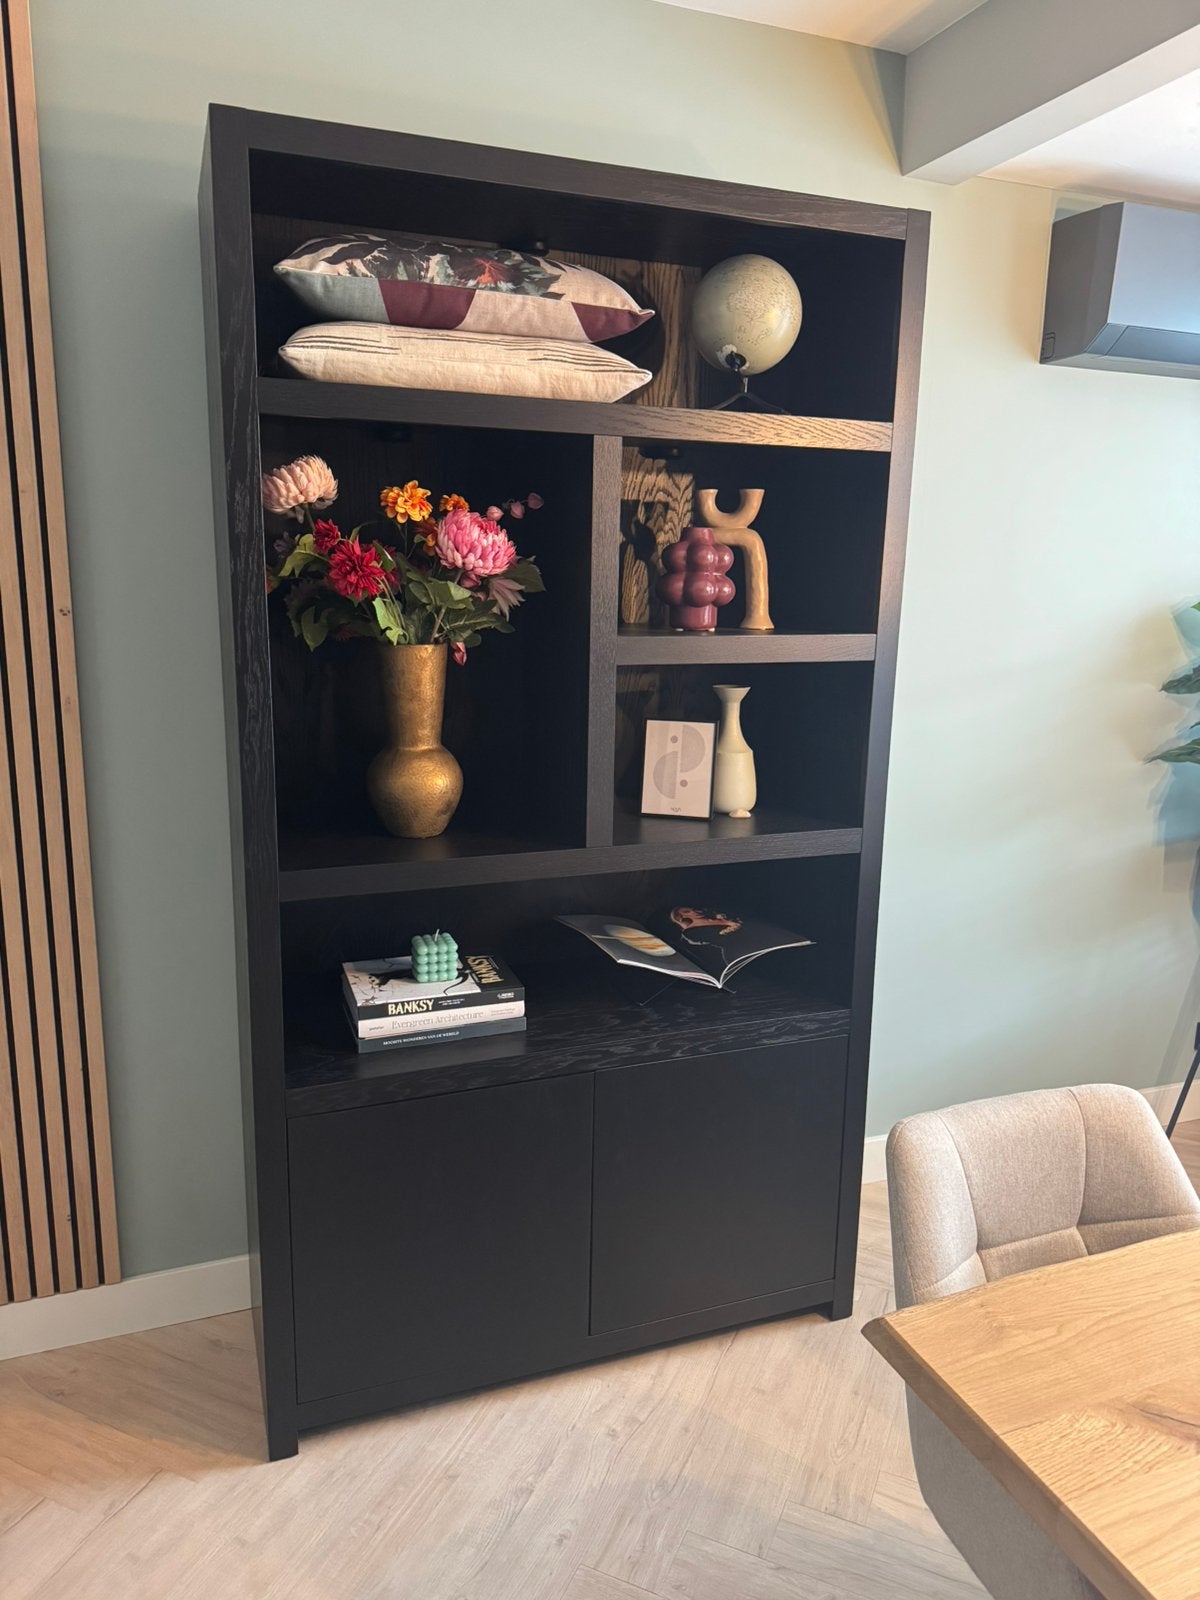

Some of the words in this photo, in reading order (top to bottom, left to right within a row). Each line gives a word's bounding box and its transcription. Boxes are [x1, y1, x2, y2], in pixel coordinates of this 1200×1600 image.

[388, 999, 434, 1016] BANKSY
[391, 1018, 433, 1030] Evergreen
[436, 1010, 484, 1024] Architecture
